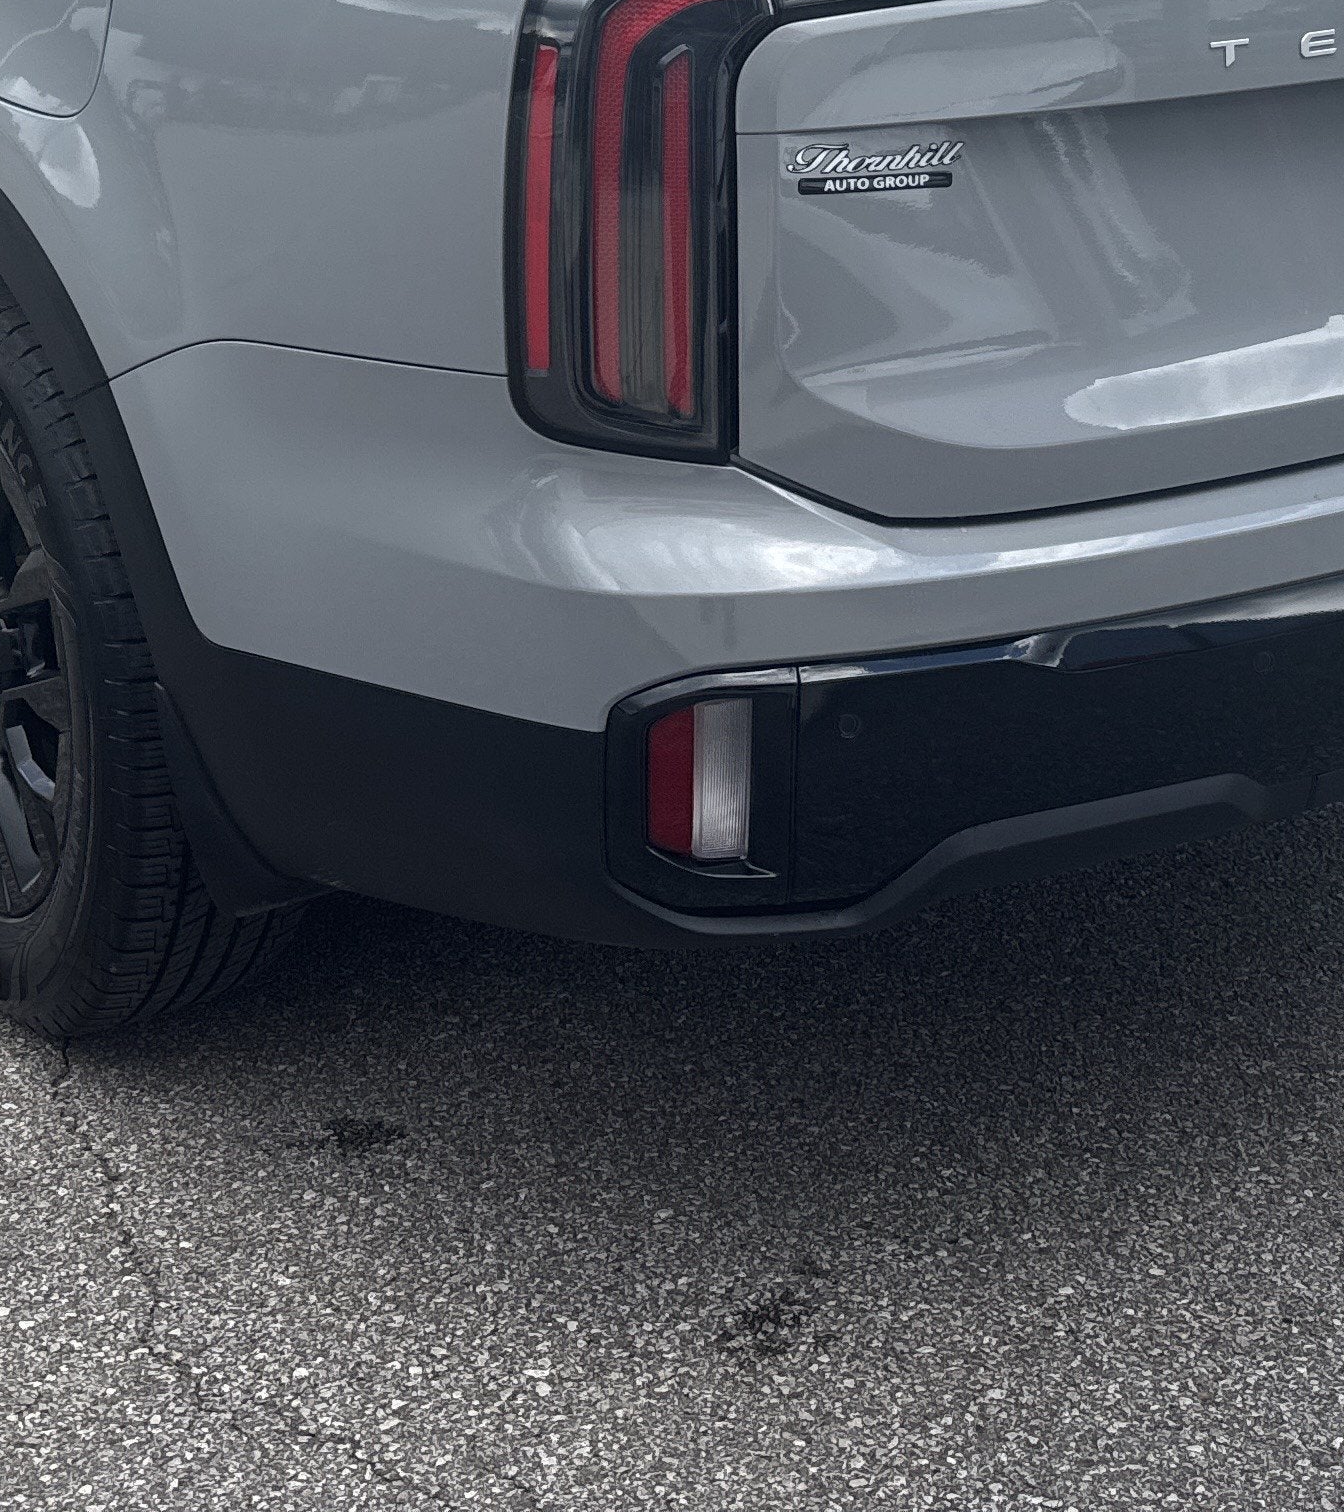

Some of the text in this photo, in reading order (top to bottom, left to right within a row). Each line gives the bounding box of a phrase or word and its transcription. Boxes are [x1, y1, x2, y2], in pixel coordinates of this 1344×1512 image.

[786, 141, 965, 174] Thornhill
[824, 174, 930, 192] AUTO GROUP
